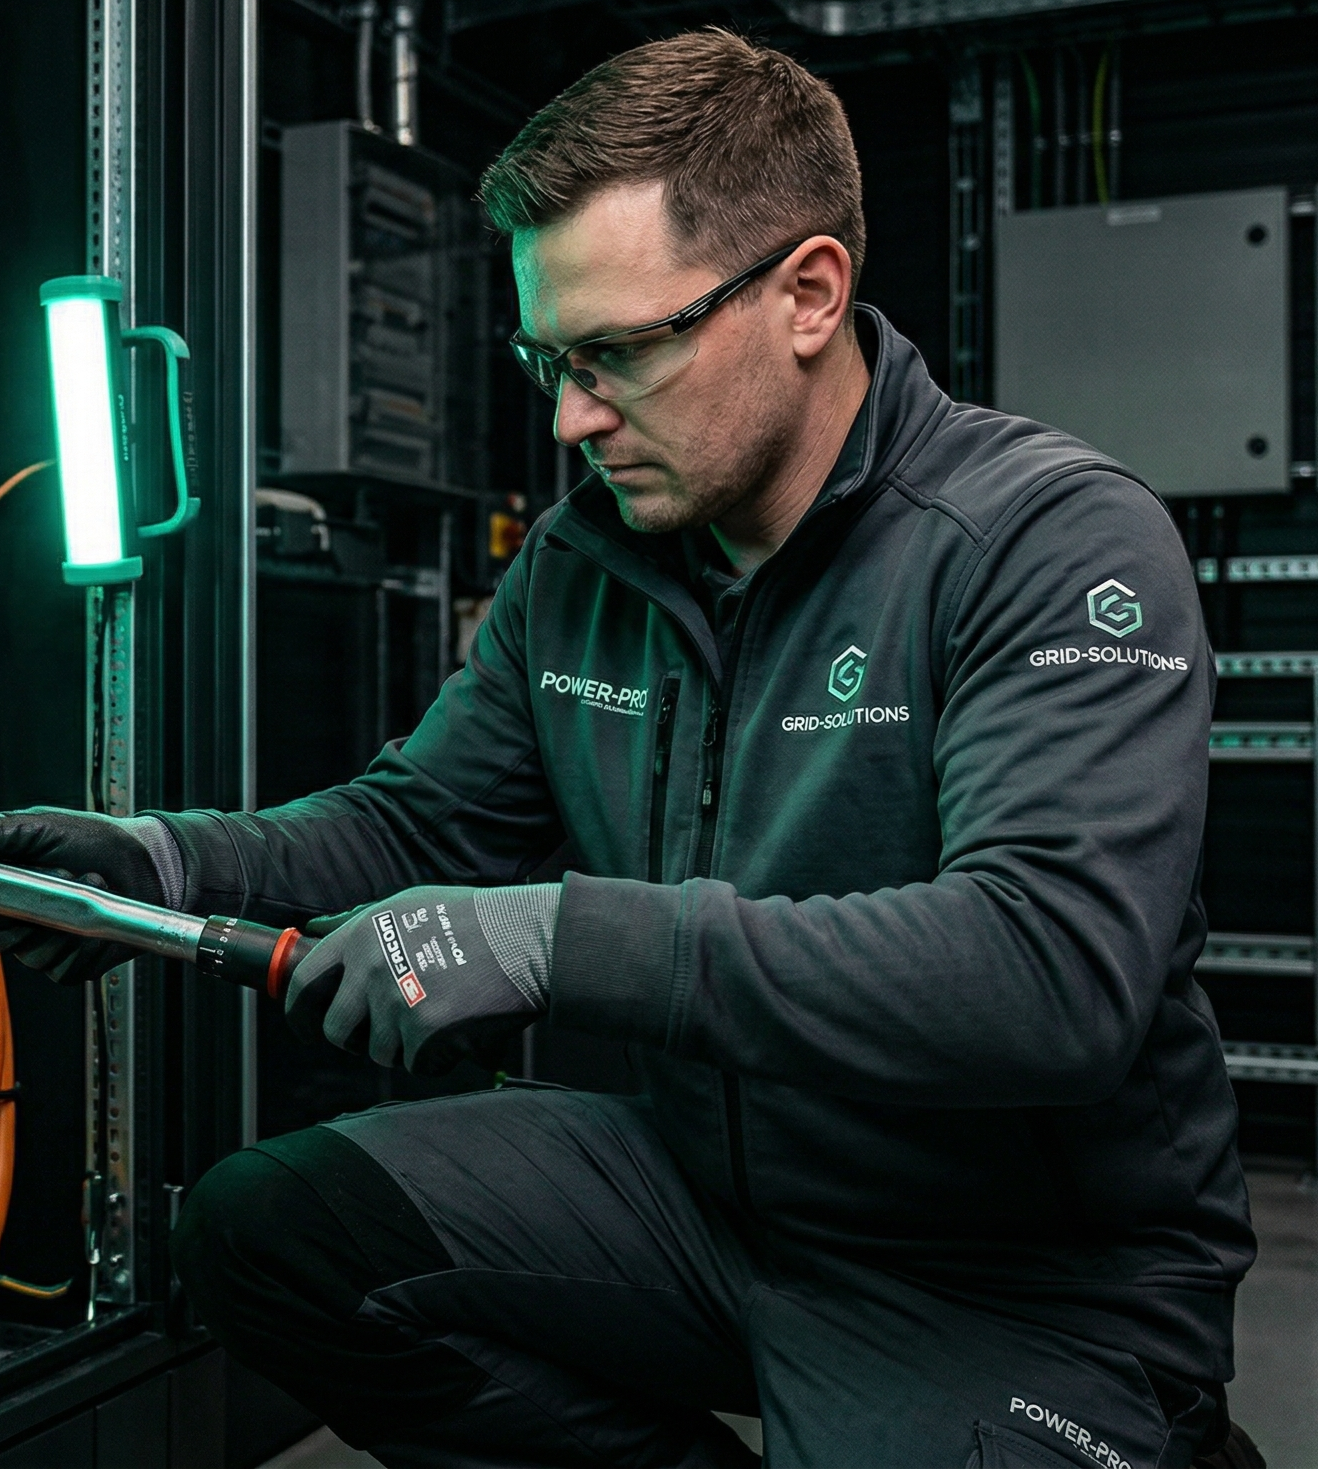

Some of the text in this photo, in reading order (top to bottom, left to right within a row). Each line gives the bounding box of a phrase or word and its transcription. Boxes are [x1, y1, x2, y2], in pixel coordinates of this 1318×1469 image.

[1029, 646, 1188, 671] GRID-SOLUTIONS
[540, 671, 648, 709] POWER-PRO
[782, 705, 910, 732] GRID-SOLUTIONS
[378, 914, 408, 975] FACOM
